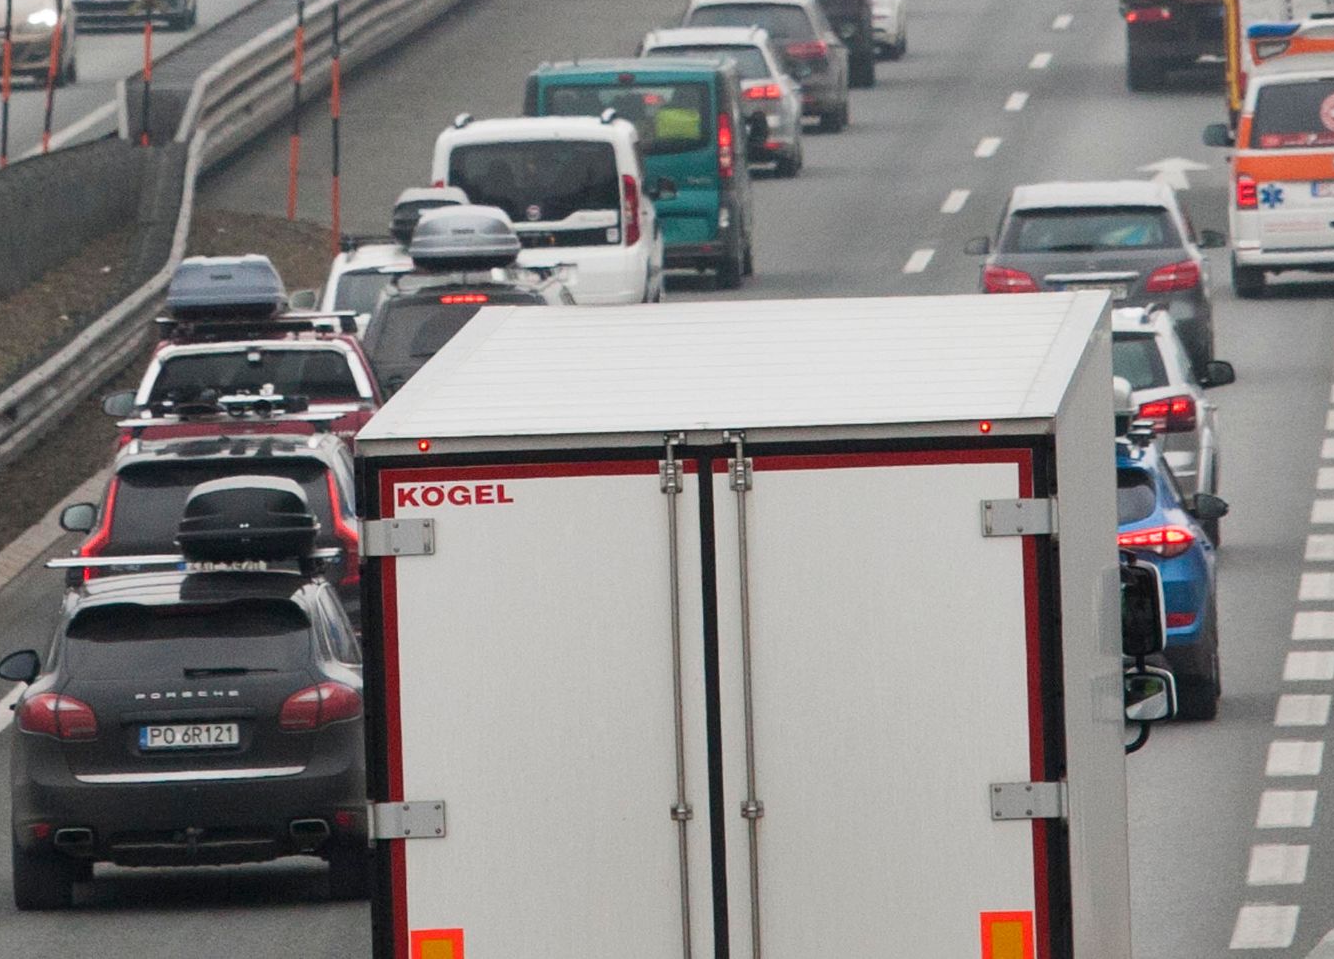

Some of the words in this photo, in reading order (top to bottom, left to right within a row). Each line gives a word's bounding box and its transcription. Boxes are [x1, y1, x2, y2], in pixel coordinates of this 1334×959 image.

[397, 483, 515, 508] KÖGEL
[135, 690, 240, 700] PORSCHE
[150, 727, 176, 745] PO
[181, 725, 234, 743] 6R121
